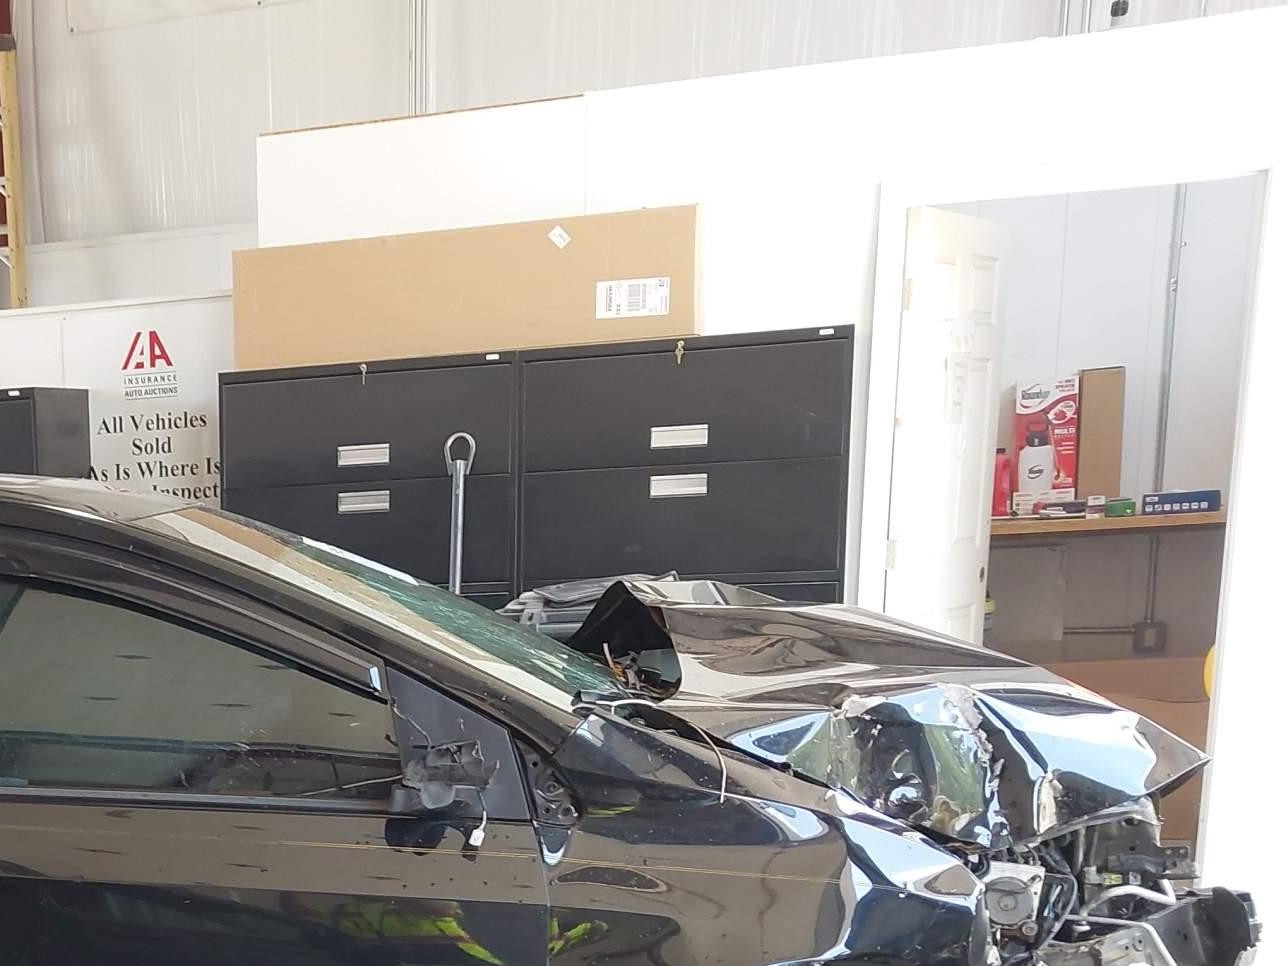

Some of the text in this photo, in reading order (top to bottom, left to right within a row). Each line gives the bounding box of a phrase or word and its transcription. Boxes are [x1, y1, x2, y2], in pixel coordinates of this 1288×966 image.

[123, 374, 177, 385] INSURANCE
[124, 386, 178, 397] AUTO AUCTIONS
[97, 411, 207, 434] All Vehicles
[132, 436, 172, 456] Sold
[90, 457, 221, 482] As Is Where Is
